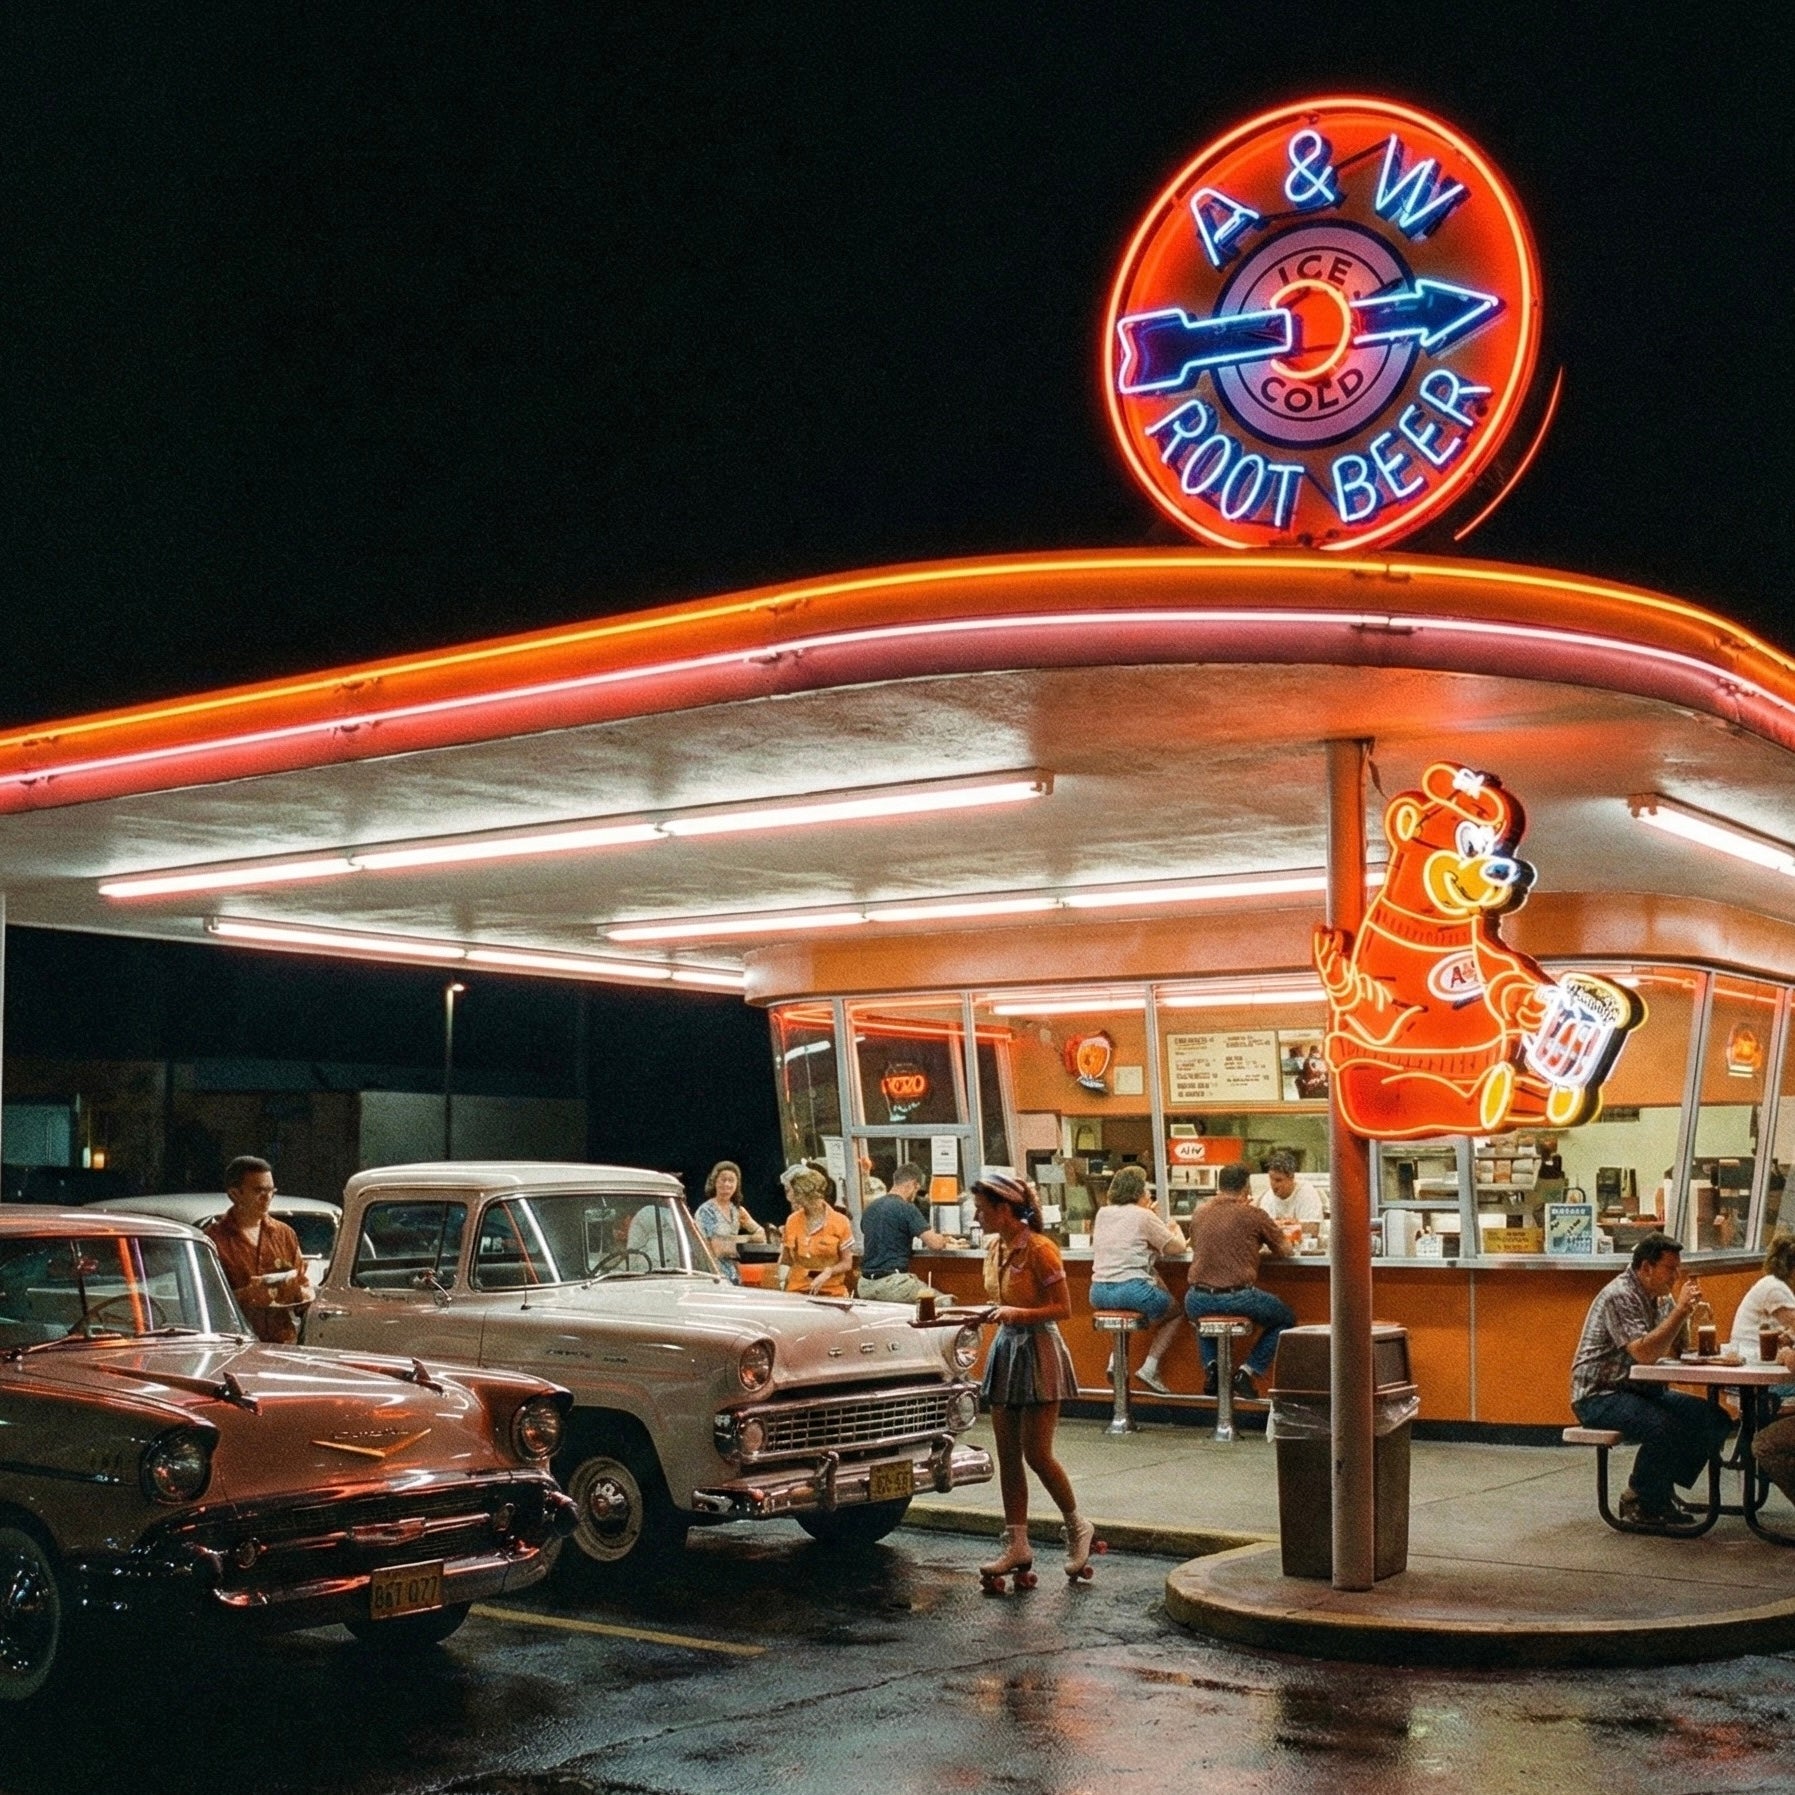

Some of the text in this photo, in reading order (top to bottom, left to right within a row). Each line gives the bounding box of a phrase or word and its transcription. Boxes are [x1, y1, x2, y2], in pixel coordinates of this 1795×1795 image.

[1189, 129, 1468, 270] A & W
[1278, 254, 1353, 286] ICE
[1260, 368, 1364, 413] COLD
[1144, 368, 1493, 528] ROOT BEER
